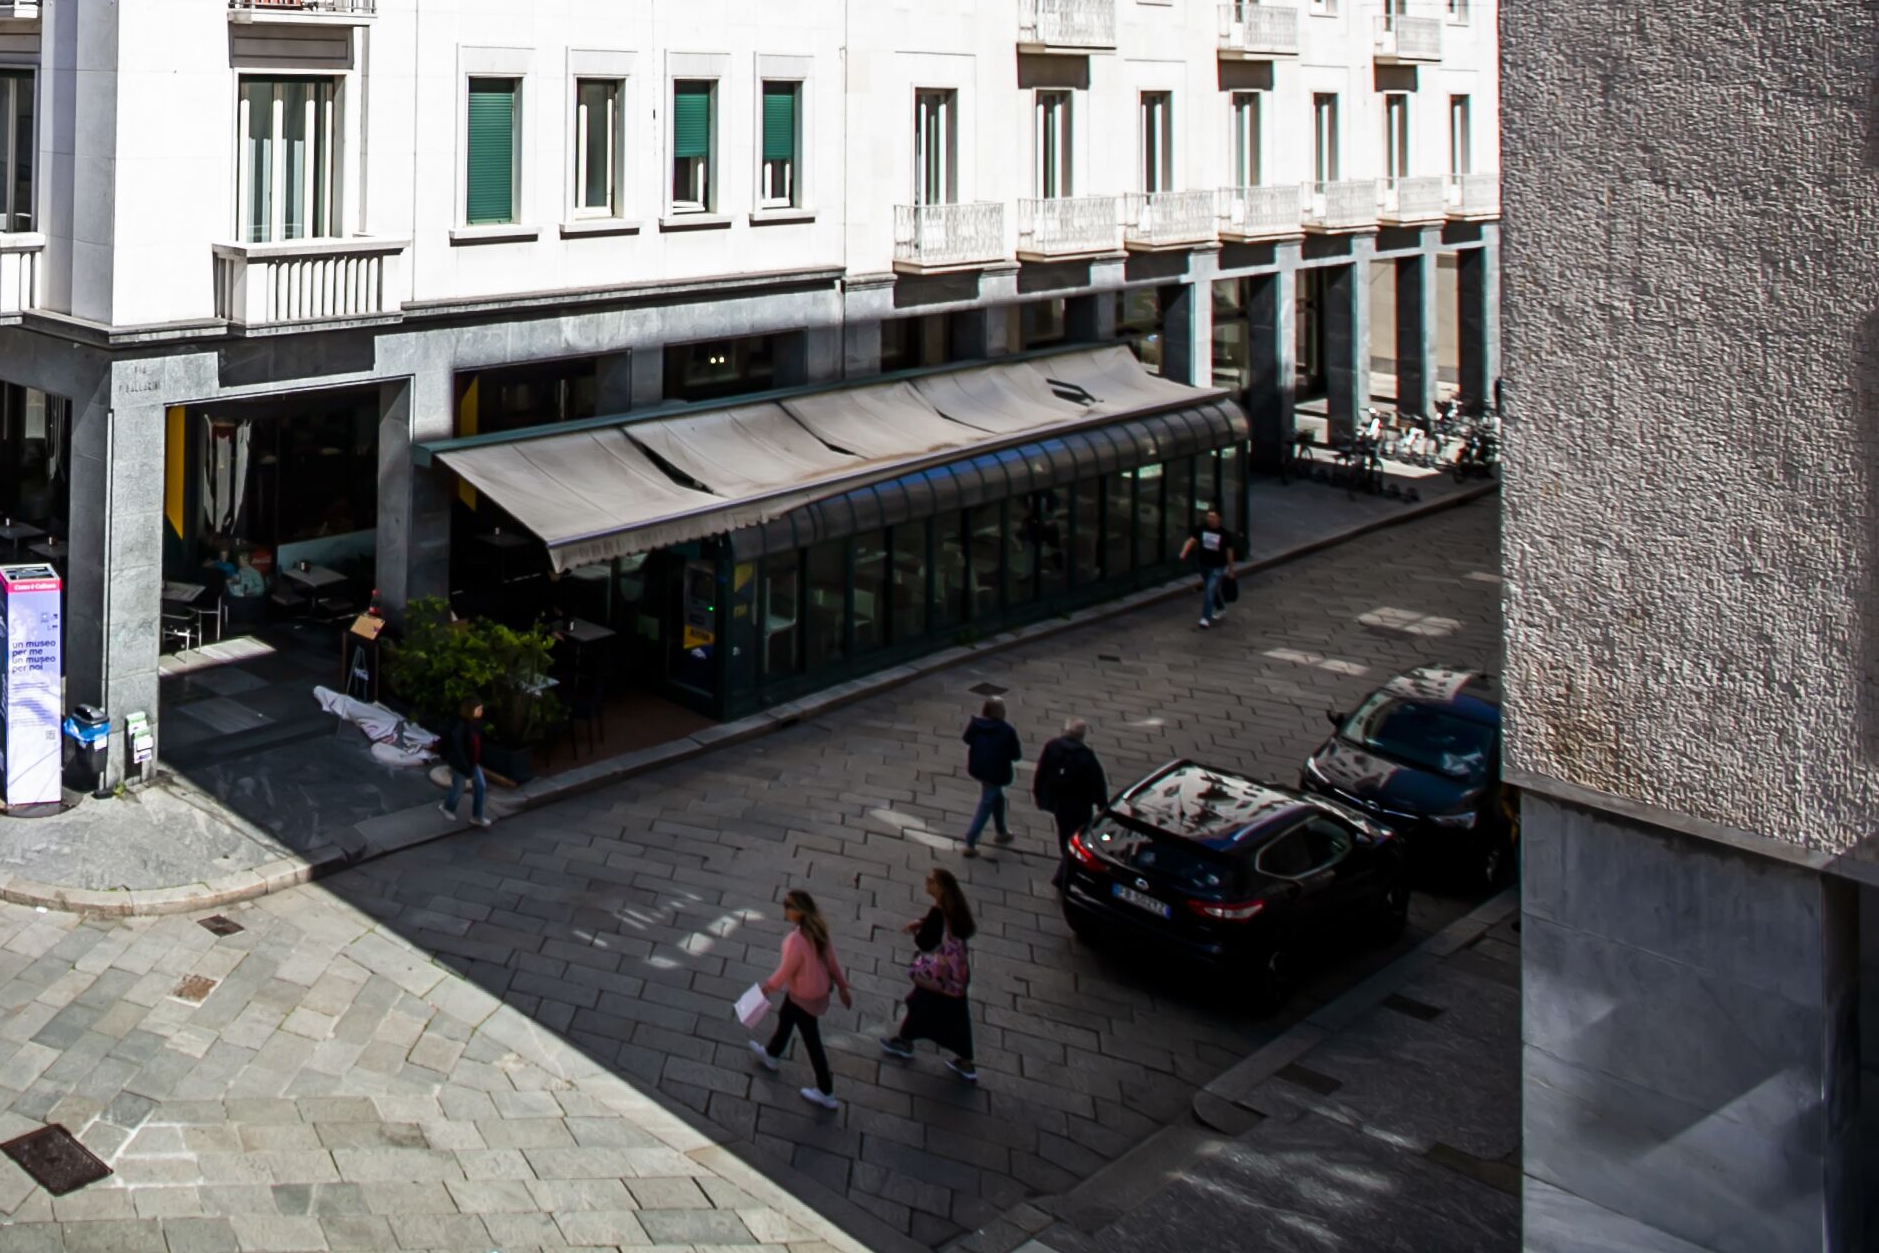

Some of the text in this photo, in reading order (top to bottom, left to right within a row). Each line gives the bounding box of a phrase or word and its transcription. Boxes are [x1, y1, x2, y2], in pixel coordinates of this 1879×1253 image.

[26, 640, 56, 648] museo
[12, 648, 43, 658] per me
[12, 656, 56, 665] un museo
[12, 665, 27, 674] per
